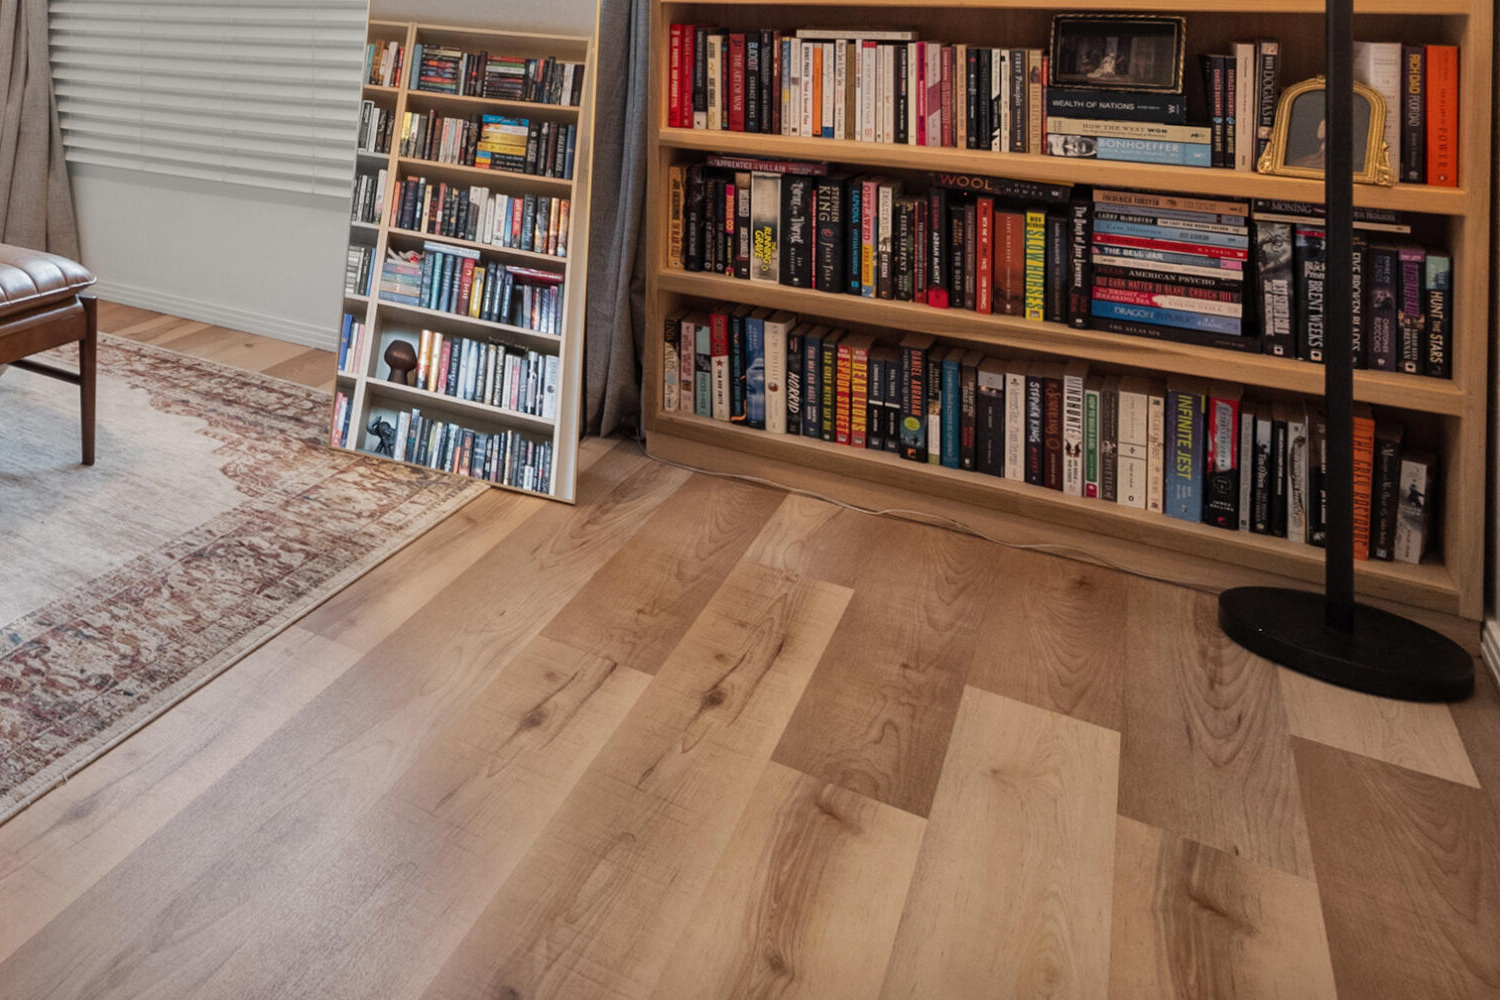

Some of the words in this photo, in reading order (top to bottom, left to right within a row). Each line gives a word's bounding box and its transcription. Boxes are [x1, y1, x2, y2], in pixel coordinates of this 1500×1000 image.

[733, 54, 742, 68] THE
[748, 42, 758, 71] BLACKOUT
[1410, 54, 1420, 73] RICH
[733, 70, 742, 85] ART
[733, 85, 741, 94] OF
[1014, 76, 1022, 106] Principles
[1409, 74, 1420, 94] DAD
[1052, 100, 1084, 108] WEALTH
[1099, 102, 1135, 110] NATIONS
[1409, 95, 1419, 113] POOR
[1409, 113, 1419, 126] DAD
[1098, 139, 1179, 152] BONHOEFFER
[716, 160, 752, 170] APPRENTICE
[759, 163, 786, 172] VILLAIN
[940, 173, 994, 190] WOOL
[819, 185, 830, 222] KING
[1074, 206, 1086, 217] The
[1270, 202, 1312, 214] MONING
[1074, 218, 1087, 236] Death
[755, 230, 764, 258] GRAVE
[764, 226, 772, 264] RUNNING
[1026, 230, 1044, 261] SLOW
[1074, 244, 1086, 258] Jane
[1104, 247, 1122, 256] THE
[1123, 248, 1144, 258] BELL
[1146, 251, 1164, 260] JAR
[1026, 265, 1044, 309] HORSES
[1074, 259, 1086, 288] Lawrence
[1128, 270, 1176, 281] AMERICAN
[1178, 276, 1216, 286] PSYCHO
[1272, 280, 1288, 295] BEST
[1273, 295, 1289, 318] SERVED
[1308, 280, 1323, 312] BRENT
[1430, 291, 1443, 320] HUNT
[1114, 306, 1154, 319] DRAGON
[1308, 314, 1323, 347] WEEKS
[1374, 317, 1382, 352] RUOCCHIO
[1430, 333, 1443, 363] STARS
[837, 360, 850, 394] SPOOK
[911, 350, 921, 376] DANIEL
[788, 371, 800, 413] HORRID
[852, 363, 867, 393] DEAD
[911, 380, 921, 416] ABRAHAM
[1029, 382, 1039, 417] STEPHEN
[1066, 378, 1081, 440] MINDHUNTER
[837, 396, 850, 434] STREET
[852, 397, 867, 432] LIONS
[1178, 394, 1192, 449] INFINITE
[1029, 419, 1039, 443] KING
[1177, 450, 1192, 480] JEST
